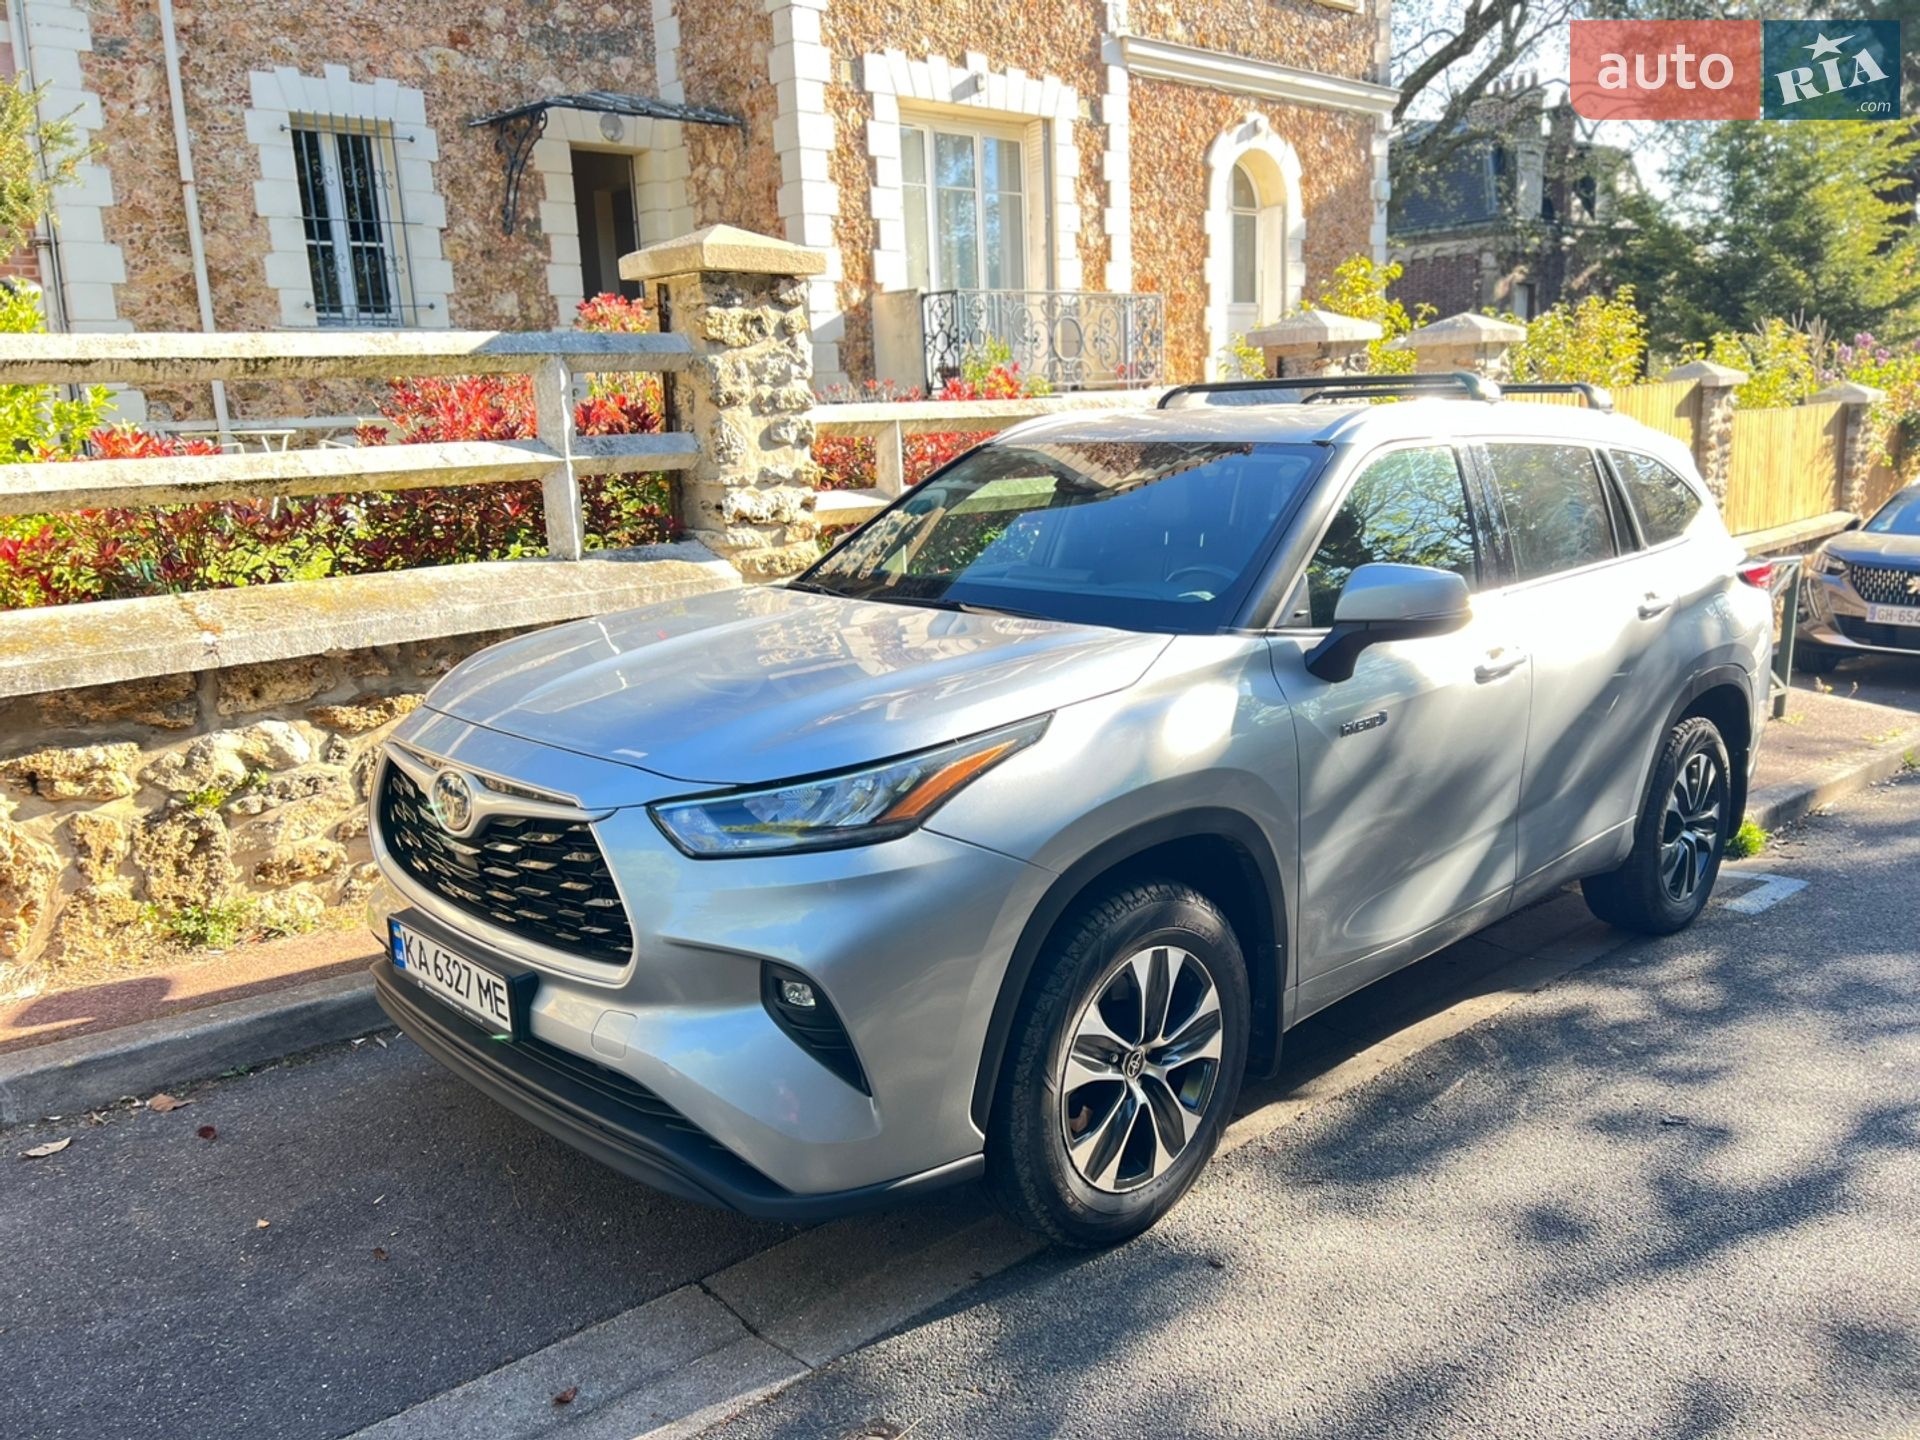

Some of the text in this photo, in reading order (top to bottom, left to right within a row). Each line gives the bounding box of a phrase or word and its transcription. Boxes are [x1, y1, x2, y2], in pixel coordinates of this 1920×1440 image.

[402, 931, 431, 977] KA
[434, 949, 472, 999] 6327
[476, 973, 508, 1022] ME
